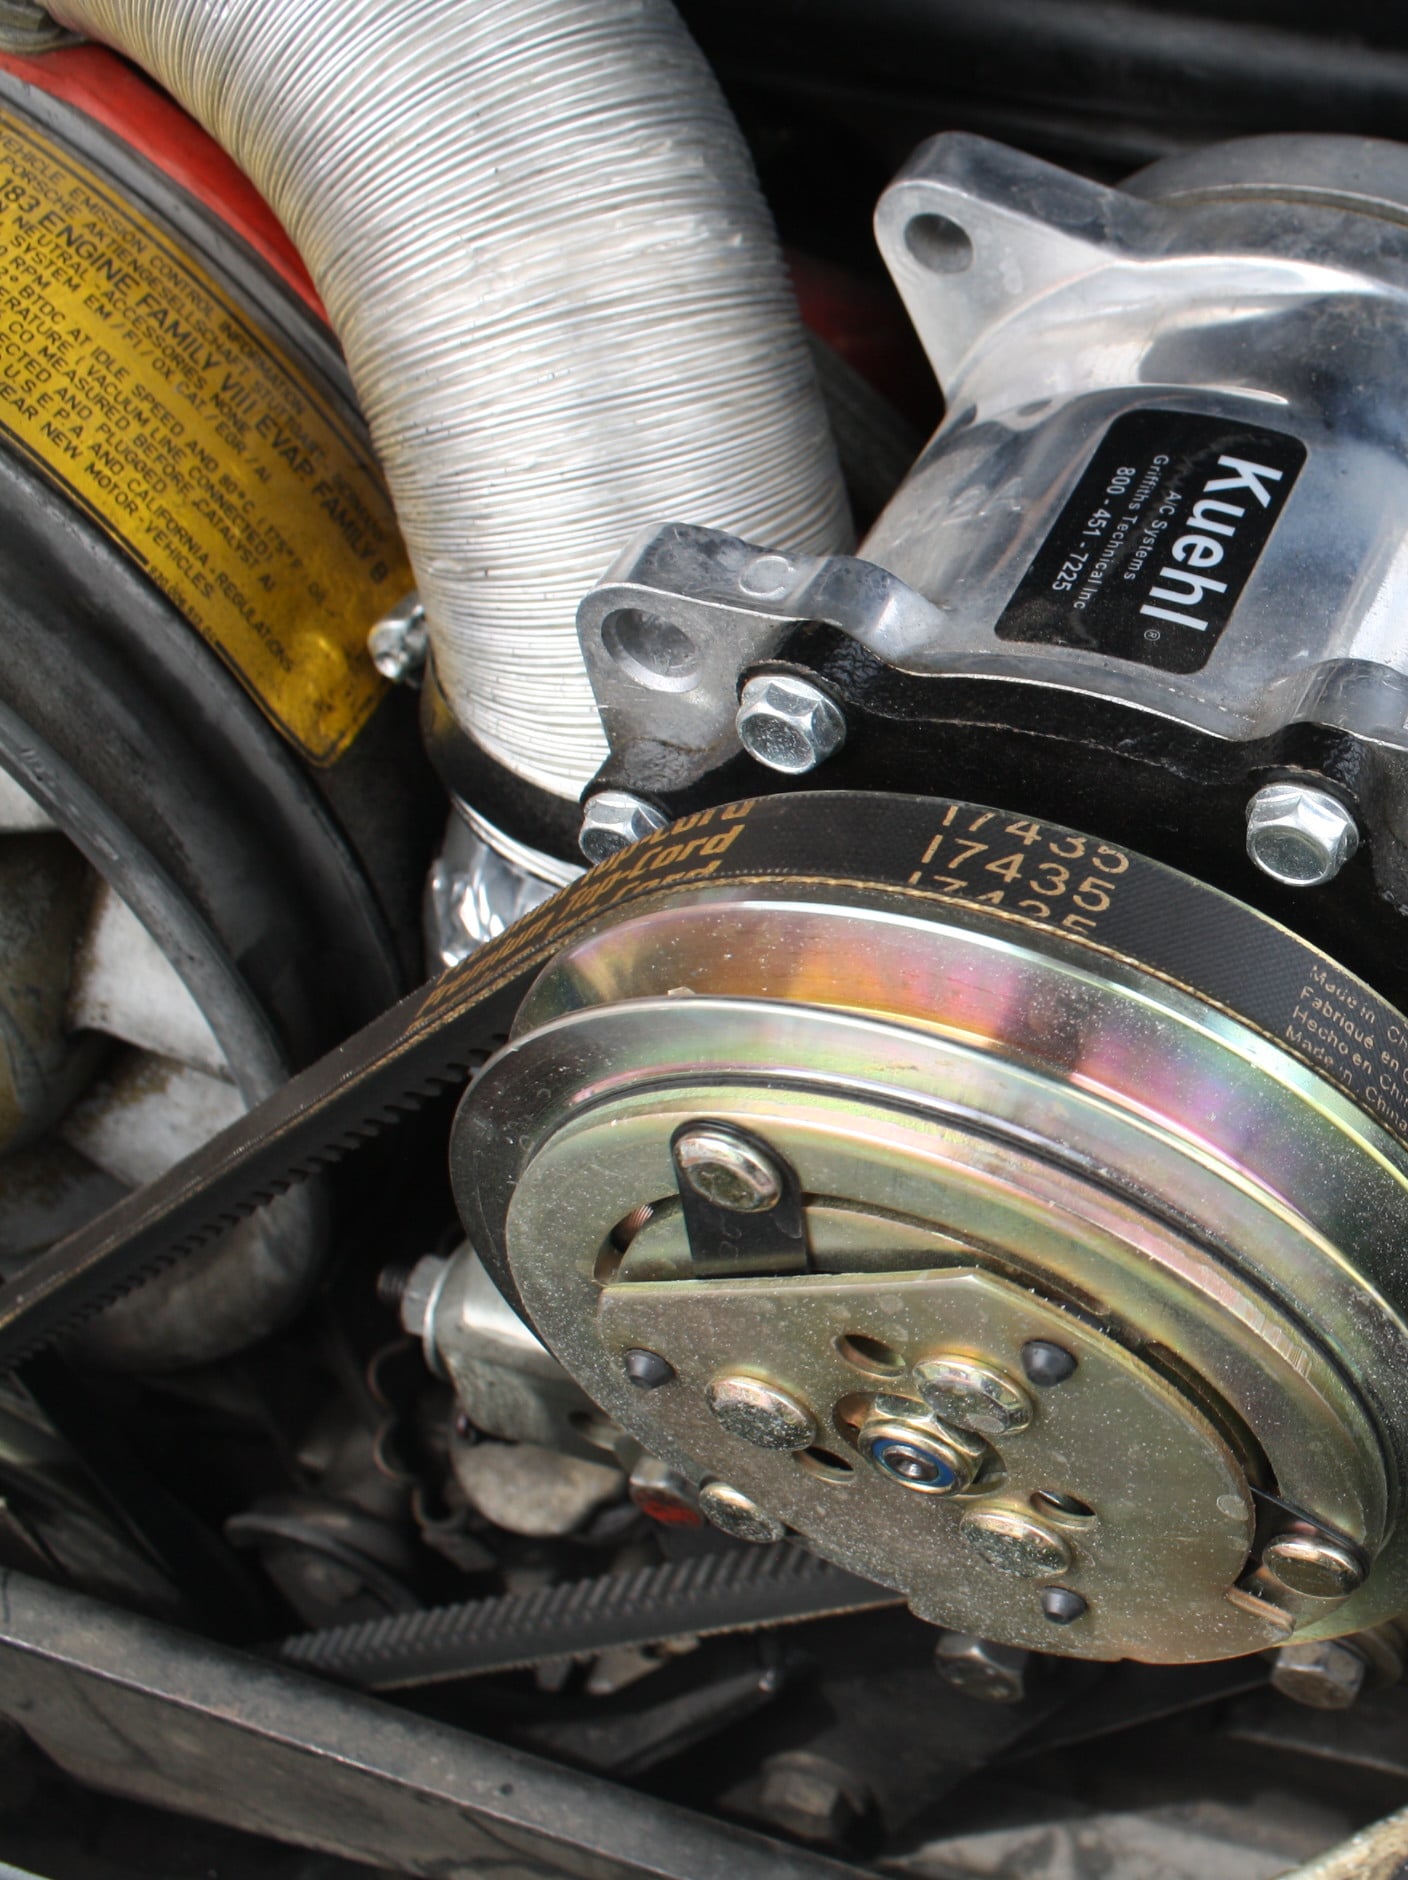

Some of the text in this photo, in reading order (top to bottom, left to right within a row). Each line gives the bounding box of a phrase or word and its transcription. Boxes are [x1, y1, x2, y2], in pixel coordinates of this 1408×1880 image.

[0, 154, 79, 218] PORSCHE
[9, 233, 81, 293] SYSTEM
[9, 254, 51, 291] RPM
[68, 186, 147, 253] EMISSION
[148, 254, 216, 318] CONTROL
[12, 214, 90, 280] NEUTRAL
[208, 392, 251, 435] NONE
[18, 285, 66, 325] BTDC
[66, 328, 93, 346] AT
[89, 346, 129, 382] IDLE
[130, 384, 185, 437] SPEED
[184, 441, 219, 473] AND
[37, 209, 140, 296] ENGINE
[135, 292, 220, 372] FAMILY
[222, 372, 257, 415] VIII
[310, 479, 376, 561] FAMILY
[36, 346, 131, 431] MEASURED
[132, 434, 194, 496] BEFORE
[39, 422, 82, 460] NEW
[53, 388, 93, 420] AND
[95, 423, 168, 494] PLUGGED
[149, 427, 187, 464] LINE
[88, 443, 125, 475] AND
[1106, 466, 1136, 495] 800
[1073, 455, 1169, 609] Griffiths Technical Inc
[1082, 509, 1112, 537] 451
[1123, 490, 1182, 581] A/C Systems
[1140, 455, 1284, 631] Kuehl
[1052, 552, 1089, 592] 7225
[921, 834, 1116, 912] 17435
[1292, 1005, 1349, 1054] Hecho
[1352, 1053, 1373, 1075] en
[1300, 985, 1375, 1050] Fabriqué
[1381, 1050, 1399, 1072] en
[1365, 1086, 1408, 1132] China
